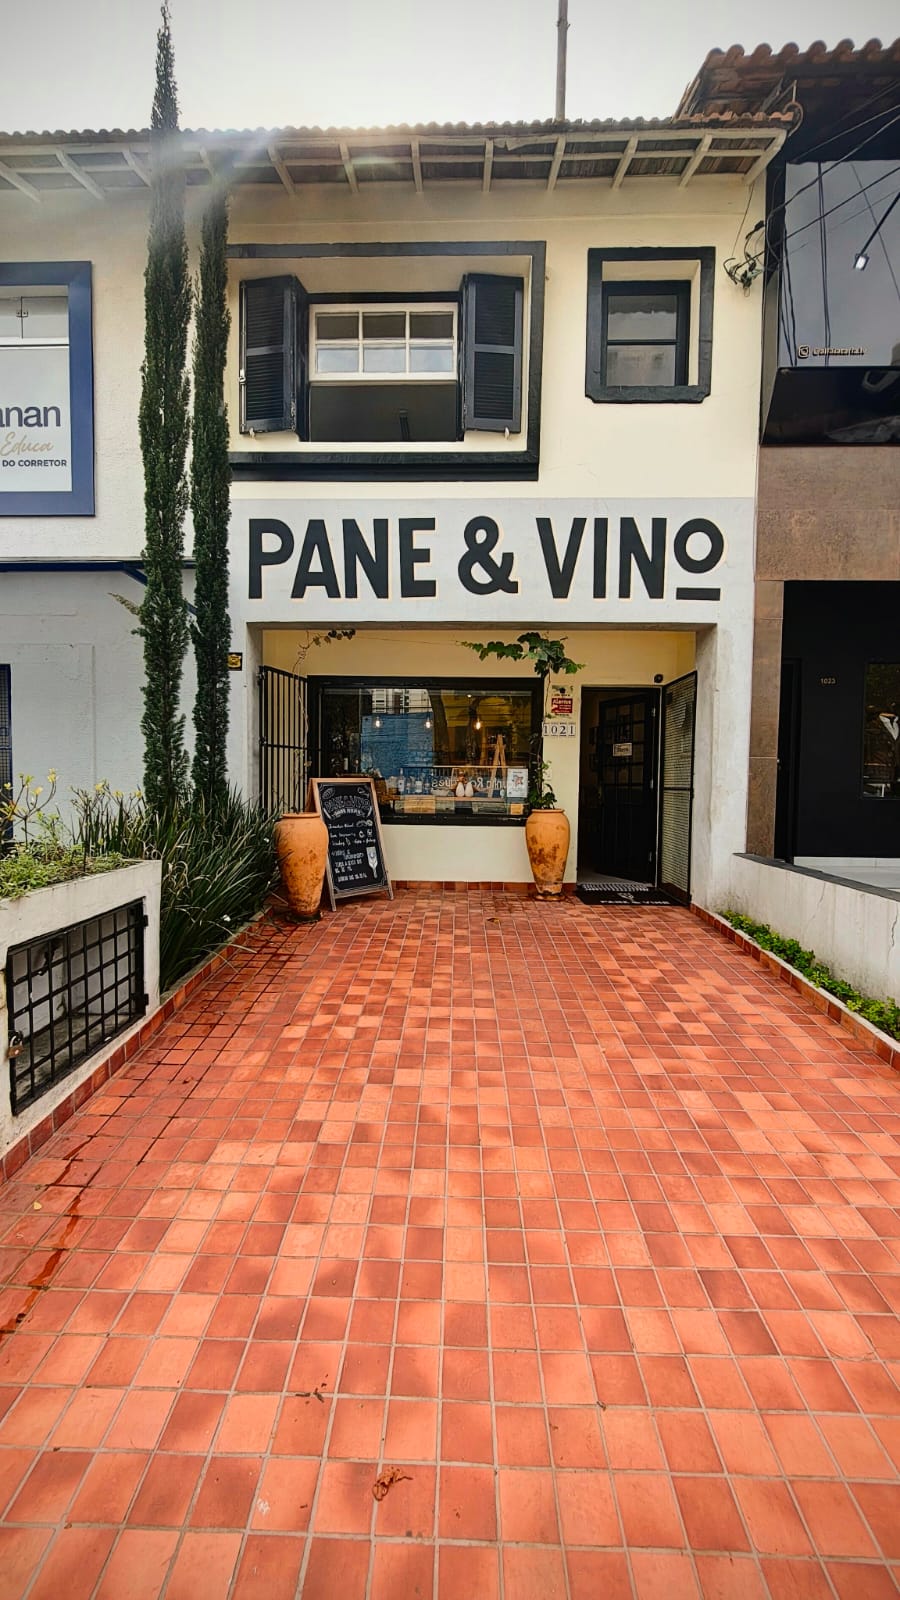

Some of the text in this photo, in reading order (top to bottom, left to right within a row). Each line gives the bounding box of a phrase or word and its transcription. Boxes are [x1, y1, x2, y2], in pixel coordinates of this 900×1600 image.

[0, 431, 54, 456] Educa
[2, 459, 67, 467] DO CORRETOR
[248, 517, 437, 600] PANE
[457, 515, 519, 597] &
[543, 725, 574, 735] 1021
